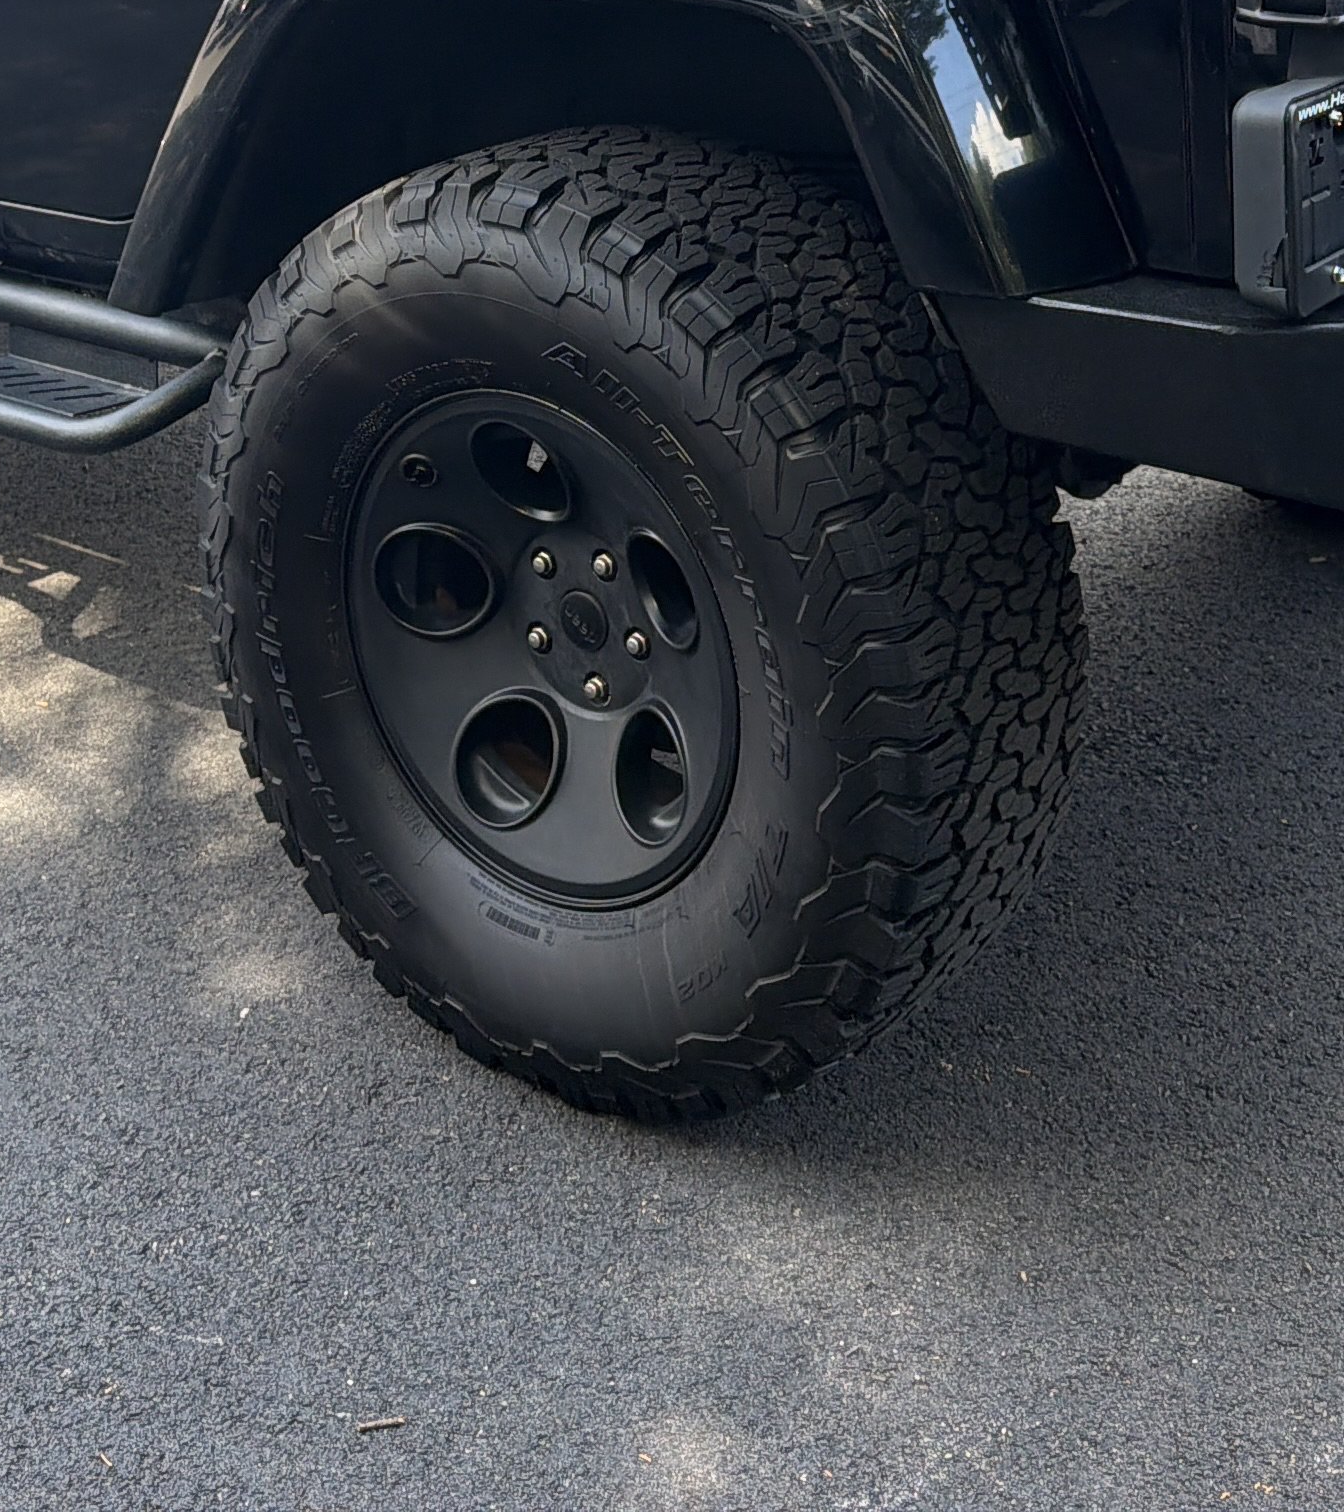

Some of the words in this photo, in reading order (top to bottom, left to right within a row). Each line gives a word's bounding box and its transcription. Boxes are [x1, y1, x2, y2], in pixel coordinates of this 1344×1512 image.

[254, 469, 412, 922] BFGoodrich
[540, 340, 793, 782] All-Terrain
[732, 822, 790, 940] T/A
